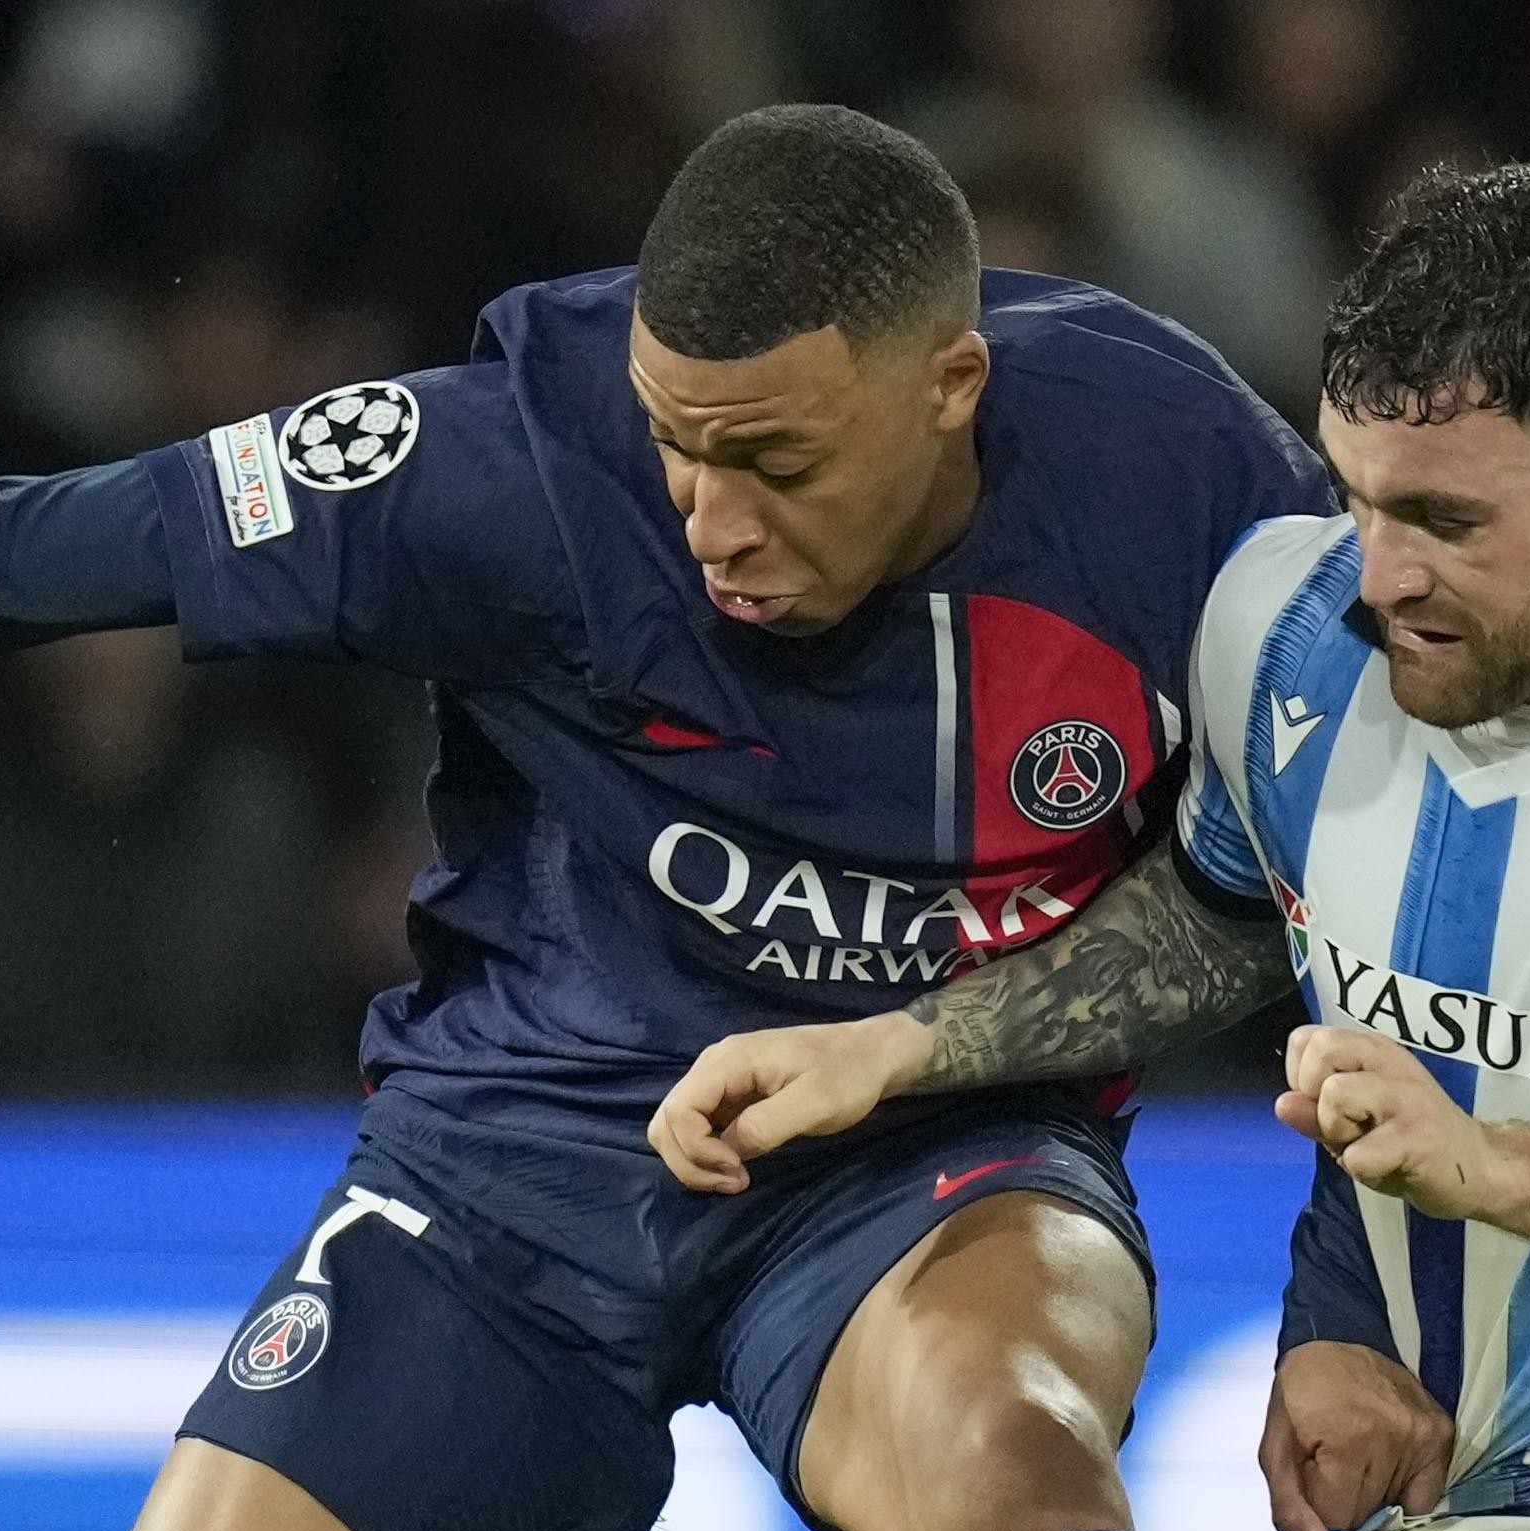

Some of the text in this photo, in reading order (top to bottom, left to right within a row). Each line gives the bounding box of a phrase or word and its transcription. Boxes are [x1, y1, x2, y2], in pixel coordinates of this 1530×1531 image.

[235, 422, 273, 537] FOUNDATION
[1028, 726, 1102, 757] PARIS
[745, 938, 994, 984] AIRWA
[271, 1301, 322, 1330] PARIS
